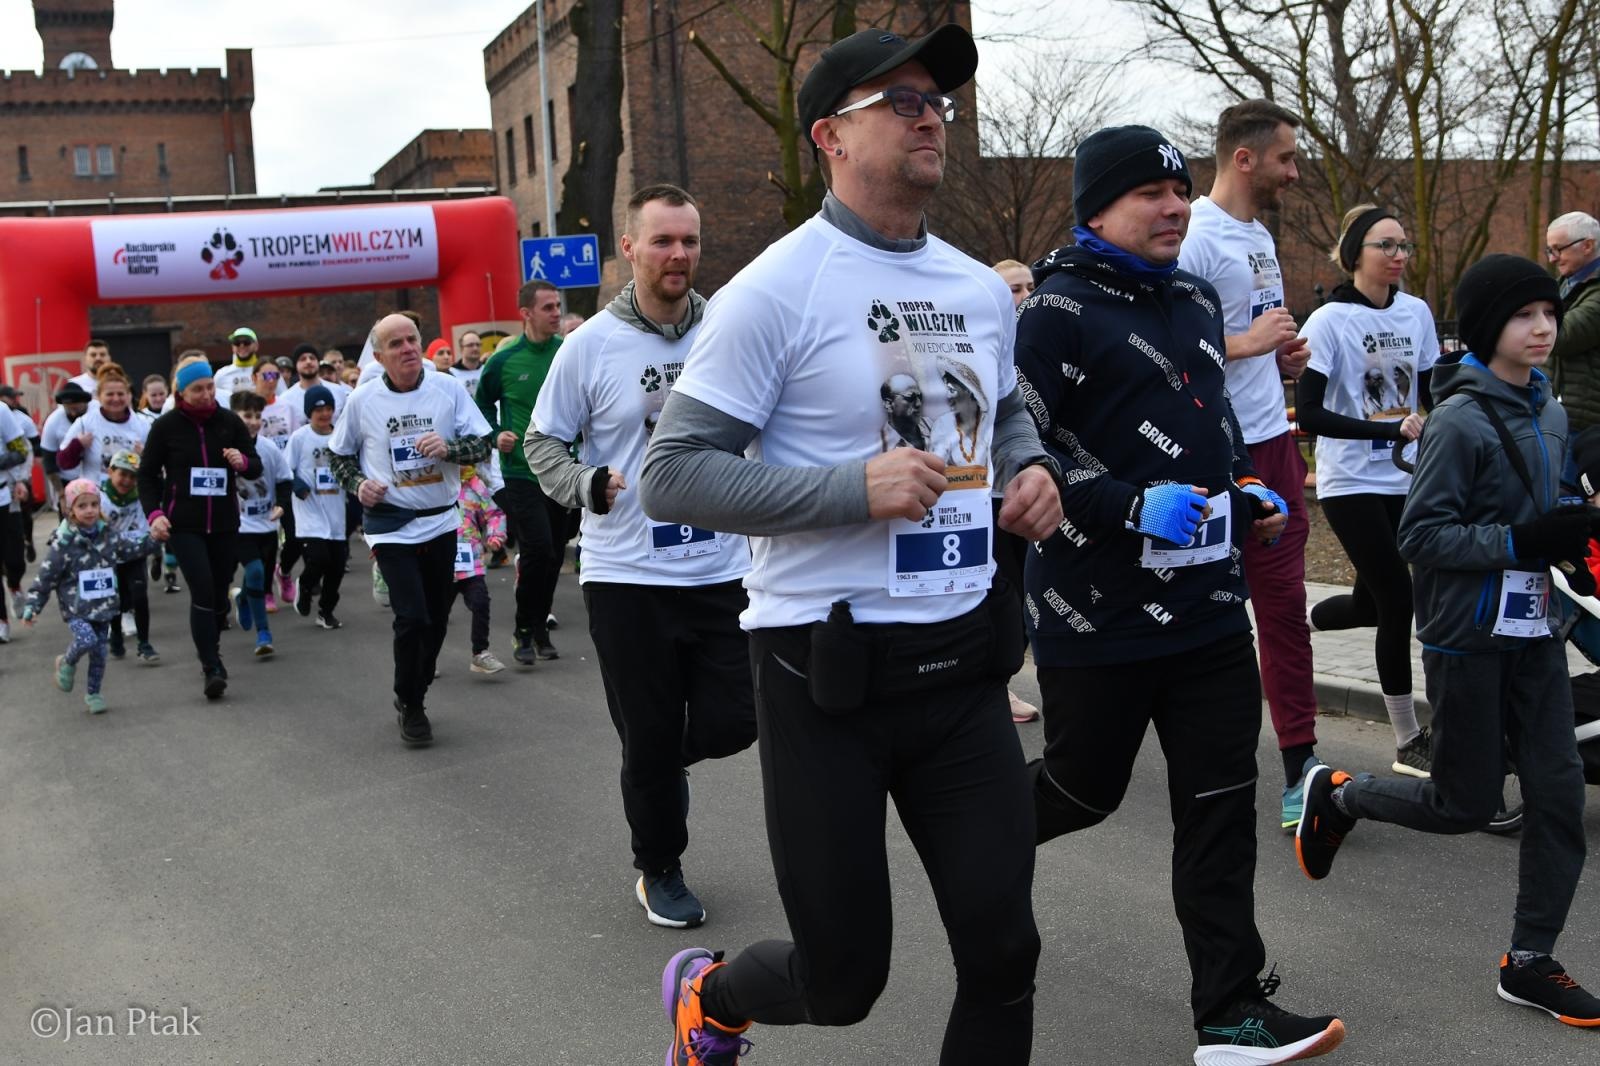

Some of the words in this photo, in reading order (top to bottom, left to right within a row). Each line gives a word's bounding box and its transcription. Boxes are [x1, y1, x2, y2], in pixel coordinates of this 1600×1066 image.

[896, 301, 936, 313] TROPEM
[1042, 293, 1084, 316] YORK
[902, 312, 967, 333] WILCZYM
[1378, 336, 1413, 348] WILCZYM
[1127, 332, 1183, 392] BROOKLYN
[1198, 338, 1226, 373] BRKL
[401, 418, 433, 428] WILCZYM
[1137, 419, 1184, 460] BRKLN
[1072, 444, 1109, 476] YORK
[202, 477, 217, 489] 43
[938, 512, 972, 526] WILCZYM
[680, 524, 693, 543] 9
[942, 533, 961, 567] 8
[94, 578, 108, 590] 45
[1042, 587, 1073, 616] NEW
[1525, 595, 1544, 618] 30
[918, 657, 959, 674] KIPRUN
